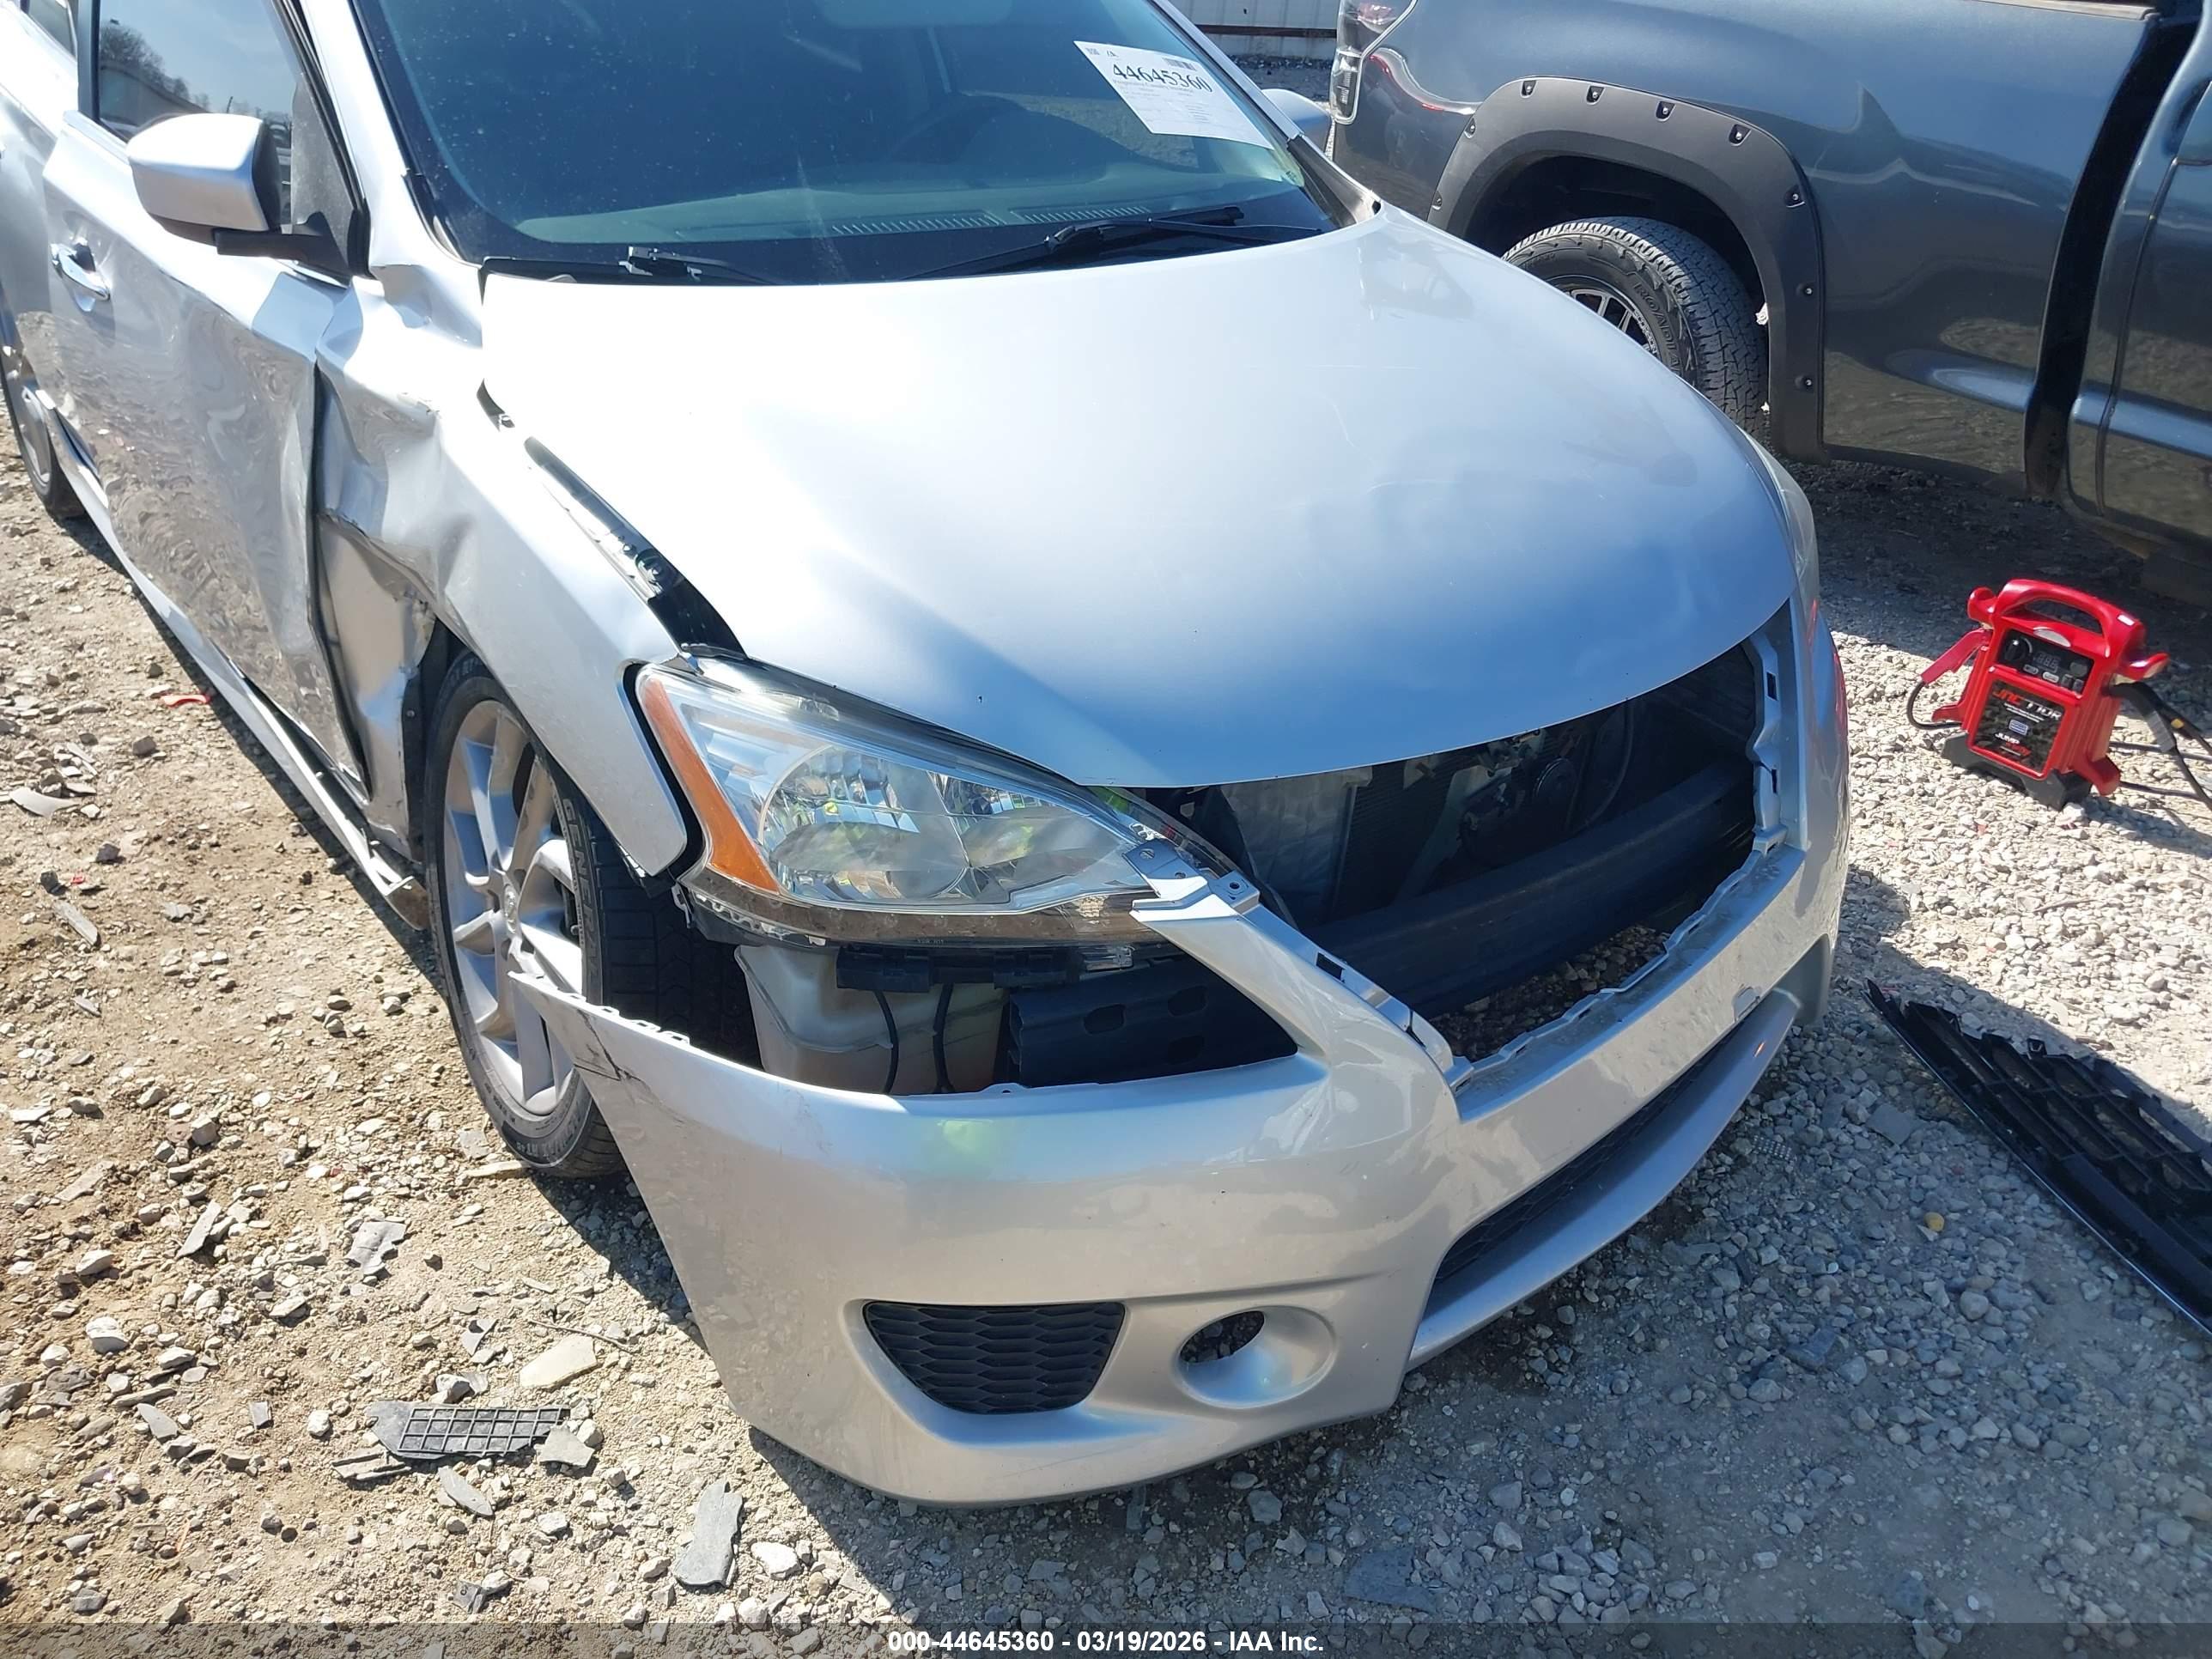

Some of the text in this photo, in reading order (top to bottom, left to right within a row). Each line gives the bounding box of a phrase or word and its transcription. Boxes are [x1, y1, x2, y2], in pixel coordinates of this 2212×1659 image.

[1113, 64, 1212, 93] 44645360
[1633, 283, 1680, 371] ROADIA
[562, 798, 599, 979] GENERAL
